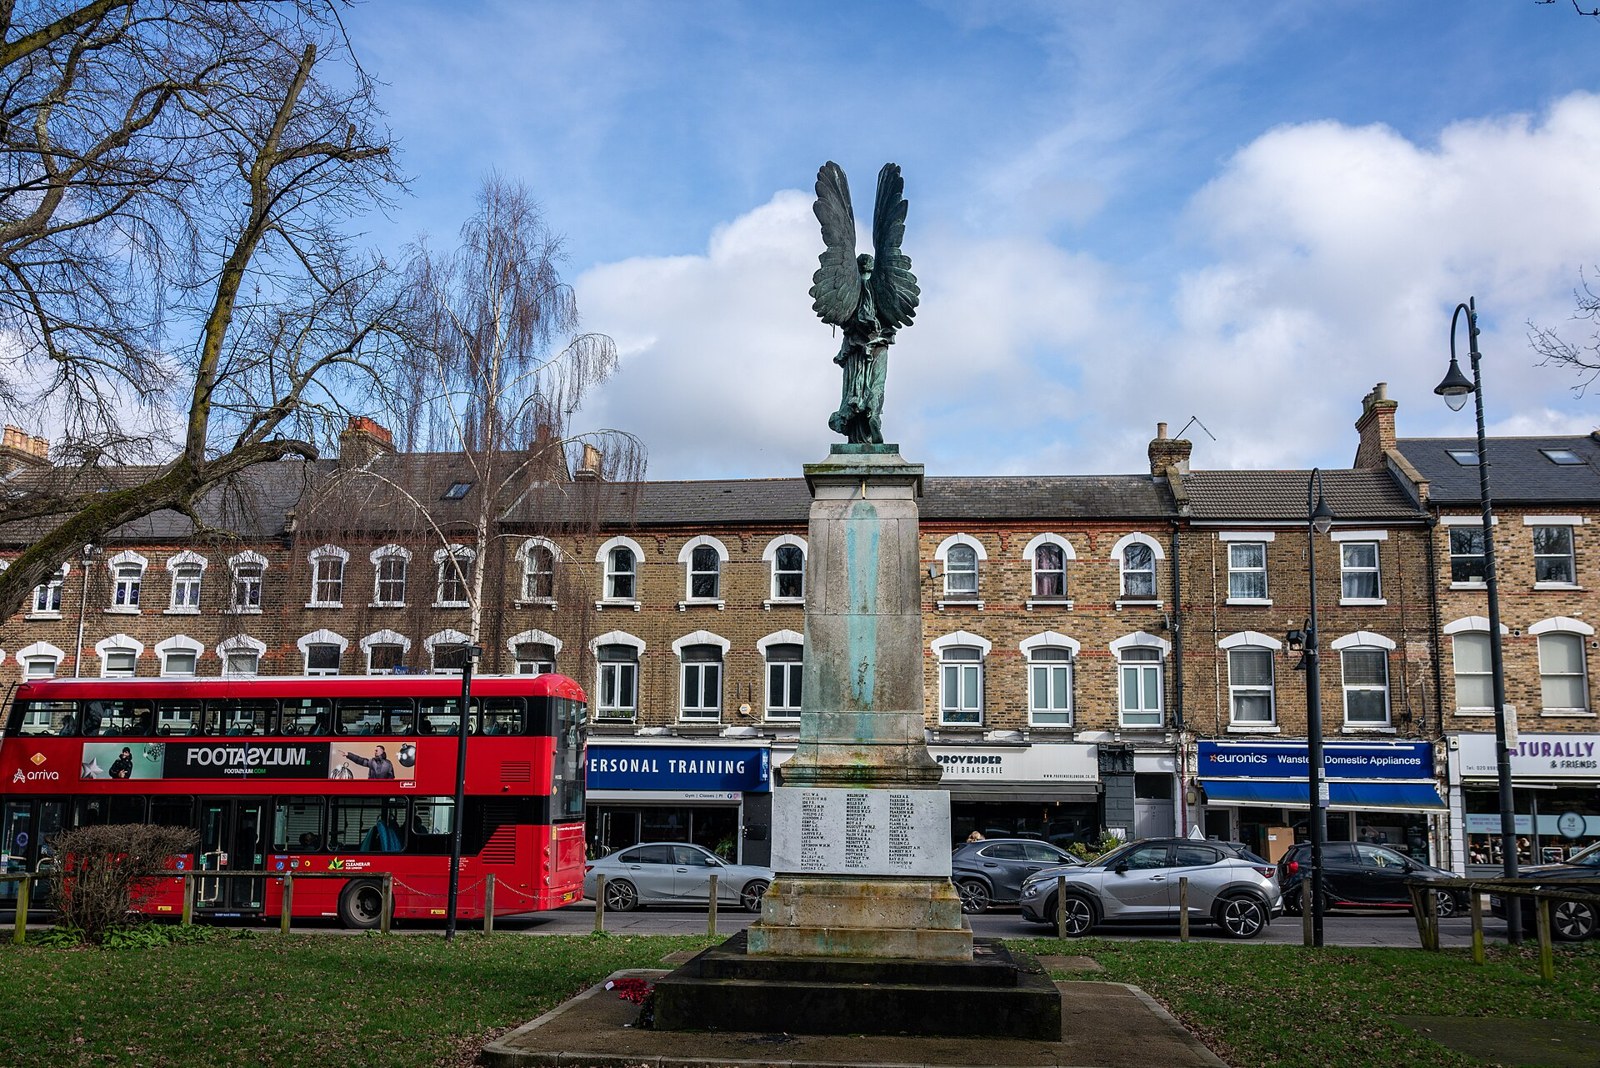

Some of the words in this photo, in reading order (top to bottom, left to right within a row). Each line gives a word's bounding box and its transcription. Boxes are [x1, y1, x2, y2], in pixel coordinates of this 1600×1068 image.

[936, 755, 1002, 765] PROVENDER
[1217, 752, 1267, 763] euronics
[1325, 756, 1368, 765] Domestic
[1370, 756, 1421, 767] Appliances
[1560, 760, 1598, 769] FRIENDS
[669, 760, 745, 774] TRAINING
[961, 766, 1002, 774] BRASSERIE
[27, 769, 59, 780] arriva
